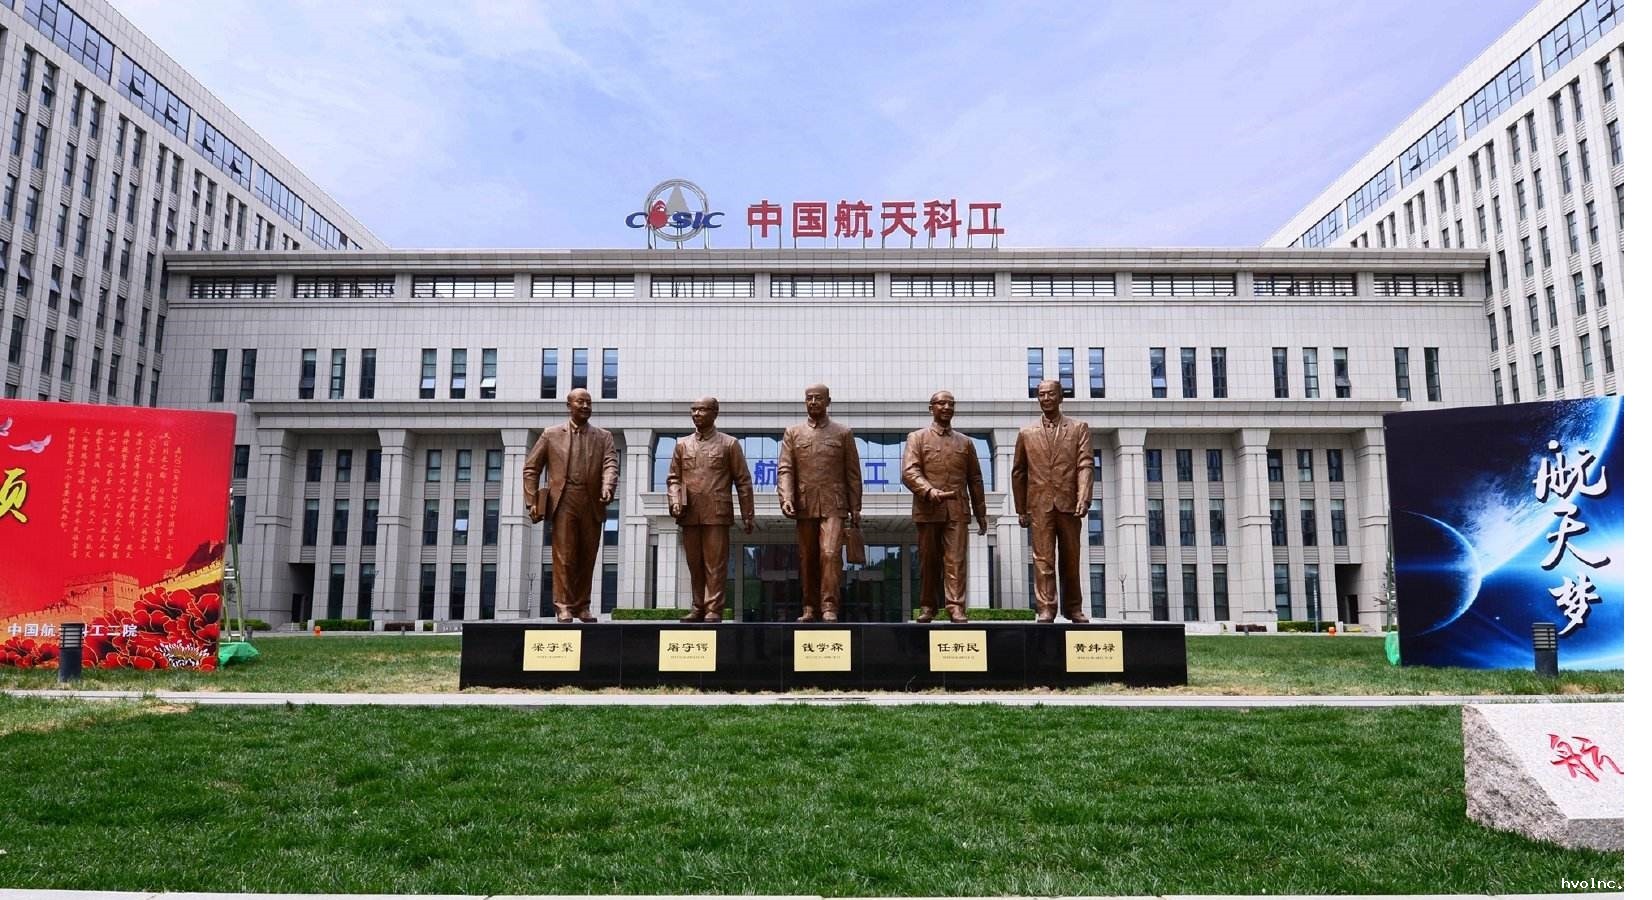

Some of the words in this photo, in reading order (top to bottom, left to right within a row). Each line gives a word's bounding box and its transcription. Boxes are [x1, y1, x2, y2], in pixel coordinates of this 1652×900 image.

[747, 199, 1005, 238] 中国航天科工
[864, 462, 889, 484] 工
[1532, 439, 1612, 636] 航天梦
[7, 622, 138, 637] 中国航工二院
[801, 642, 844, 652] 钱学森
[937, 642, 980, 652] 任新民
